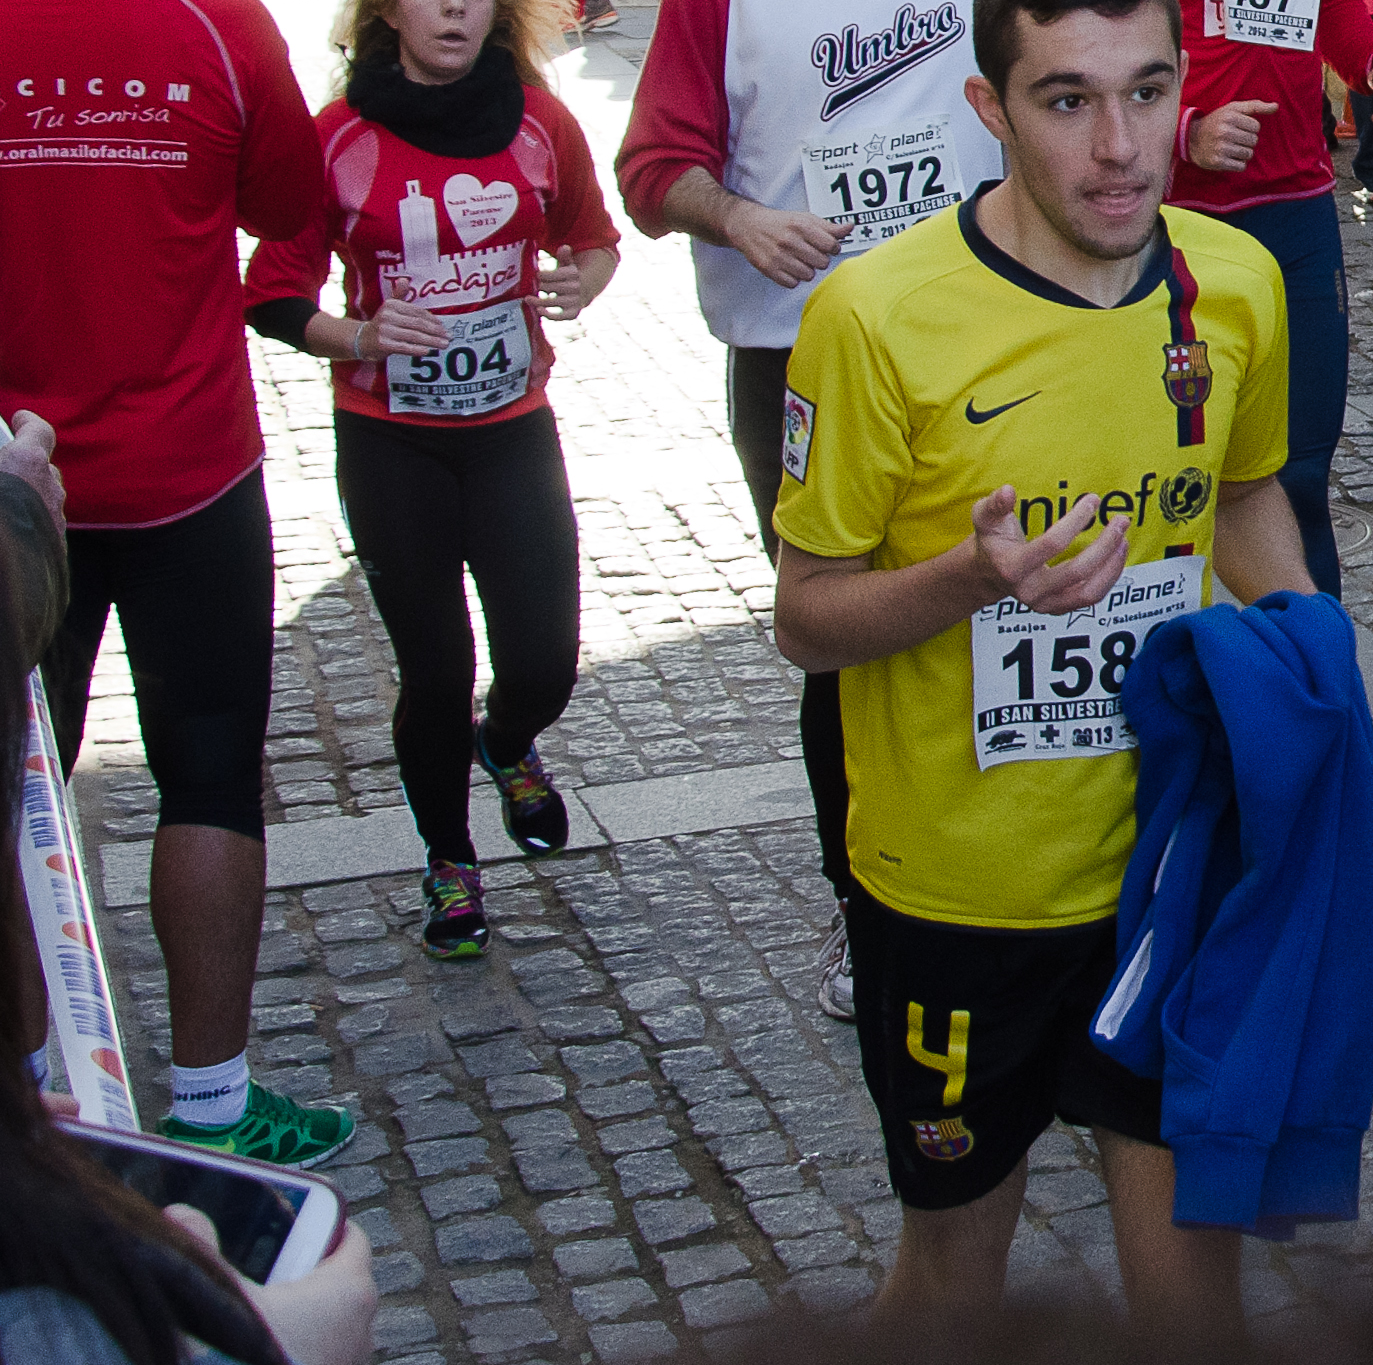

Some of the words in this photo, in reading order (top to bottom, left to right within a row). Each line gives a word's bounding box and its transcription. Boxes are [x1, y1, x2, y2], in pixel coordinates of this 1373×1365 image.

[1236, 9, 1273, 23] SILVESTRE
[1274, 13, 1309, 28] PACENSE
[811, 2, 964, 87] Umbro
[16, 77, 191, 103] CICOM
[26, 106, 65, 130] Tu
[74, 103, 171, 126] sonrisa
[809, 142, 859, 162] Sport
[830, 155, 945, 212] 1972
[858, 205, 911, 224] SILVESTRE
[913, 194, 956, 212] PACENSE
[881, 224, 906, 238] 2013
[384, 260, 518, 302] Badajoz
[410, 338, 512, 383] 504
[432, 382, 482, 395] SILVESTRE
[451, 396, 476, 410] 2013
[997, 624, 1047, 634] Badajoz
[1001, 622, 1158, 701] 158
[1001, 706, 1034, 723] SAN
[1041, 699, 1122, 721] SILVESTRE
[906, 1001, 970, 1107] 4
